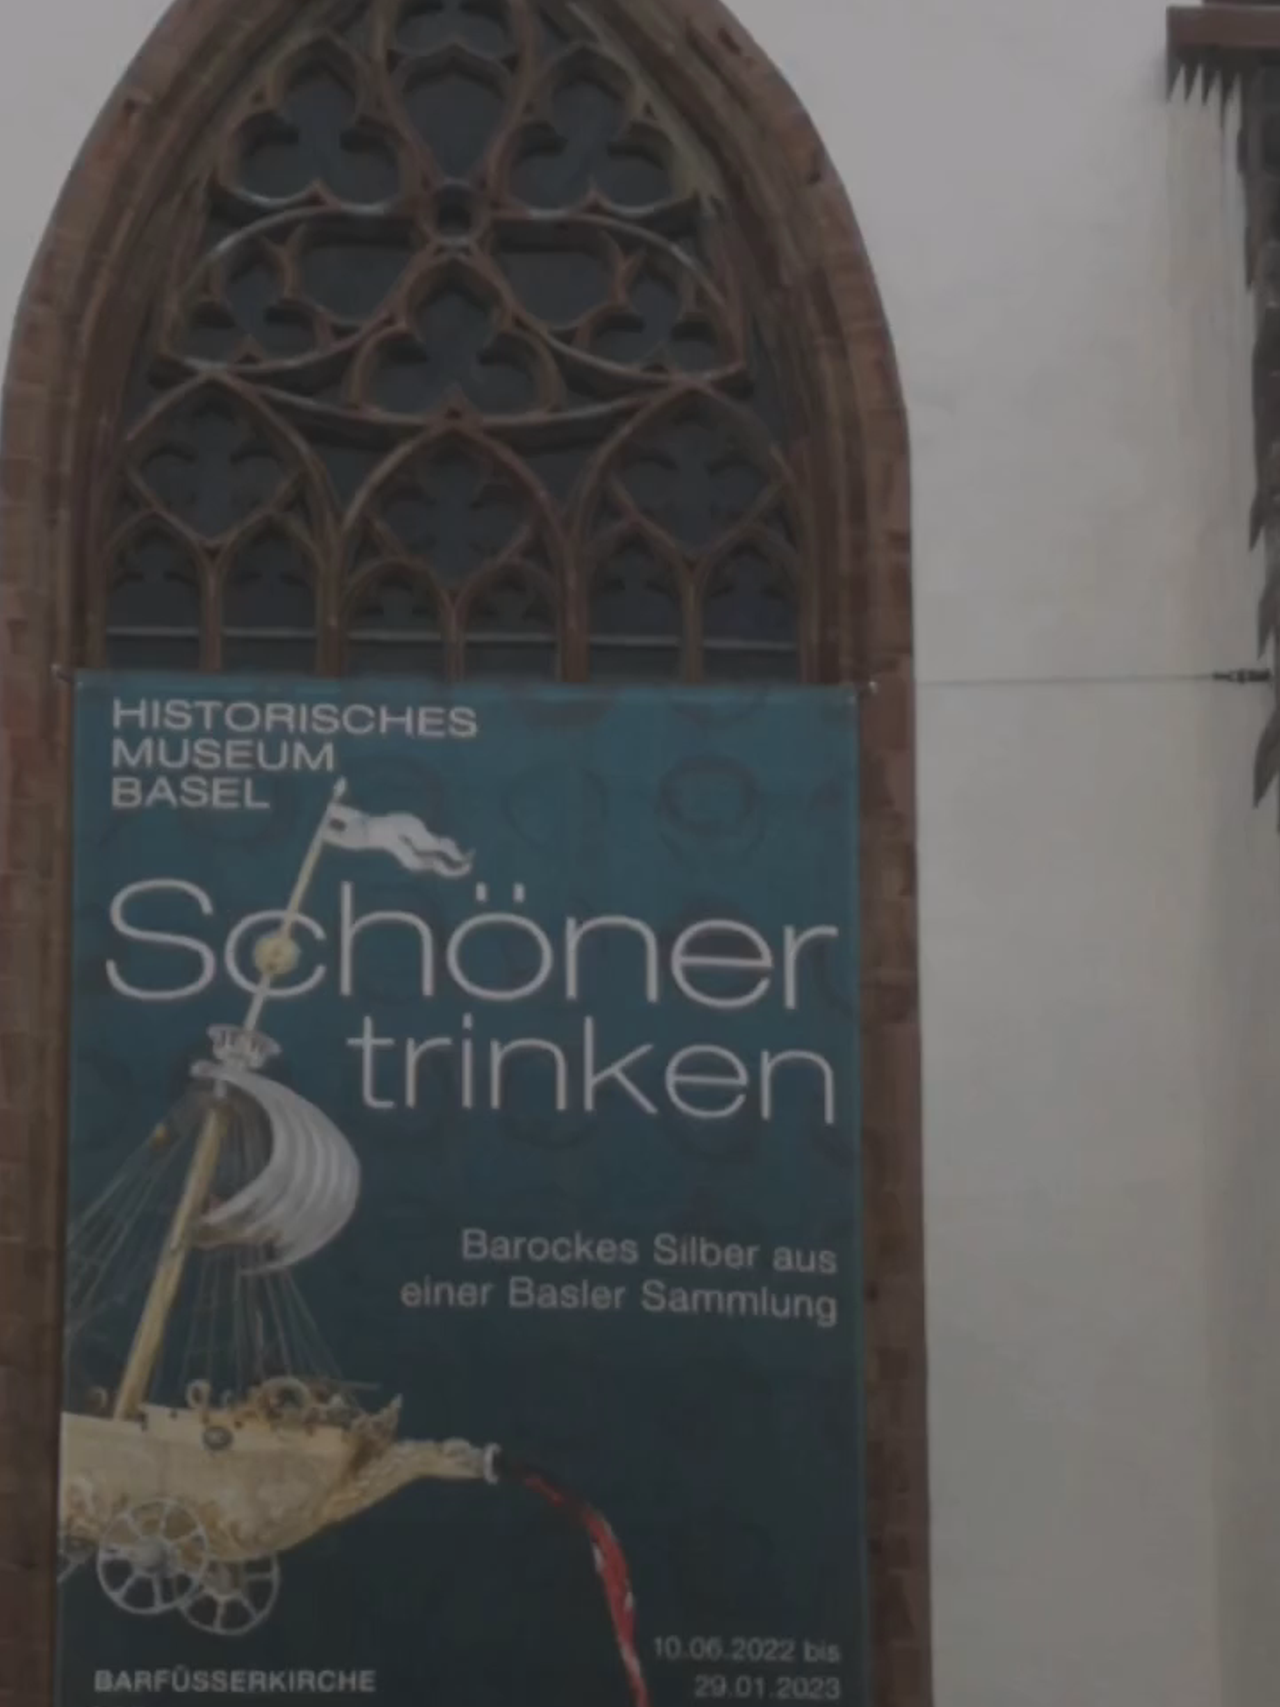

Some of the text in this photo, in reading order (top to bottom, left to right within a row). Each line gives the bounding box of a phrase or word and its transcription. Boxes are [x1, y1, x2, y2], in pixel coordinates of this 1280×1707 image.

[111, 698, 479, 739] HISTORISCHES
[111, 738, 336, 773] MUSEUM
[111, 777, 271, 810] BASEL
[105, 878, 839, 1011] Schöner
[347, 1013, 836, 1126] trinken
[461, 1227, 838, 1275] Barockes Silber aus
[400, 1275, 838, 1328] einer Basler Sammlung
[653, 1635, 841, 1663] 10.06.2022 bis
[94, 1664, 377, 1693] BARFÜSSERKIRCHE
[694, 1674, 841, 1700] 29.01.2023
